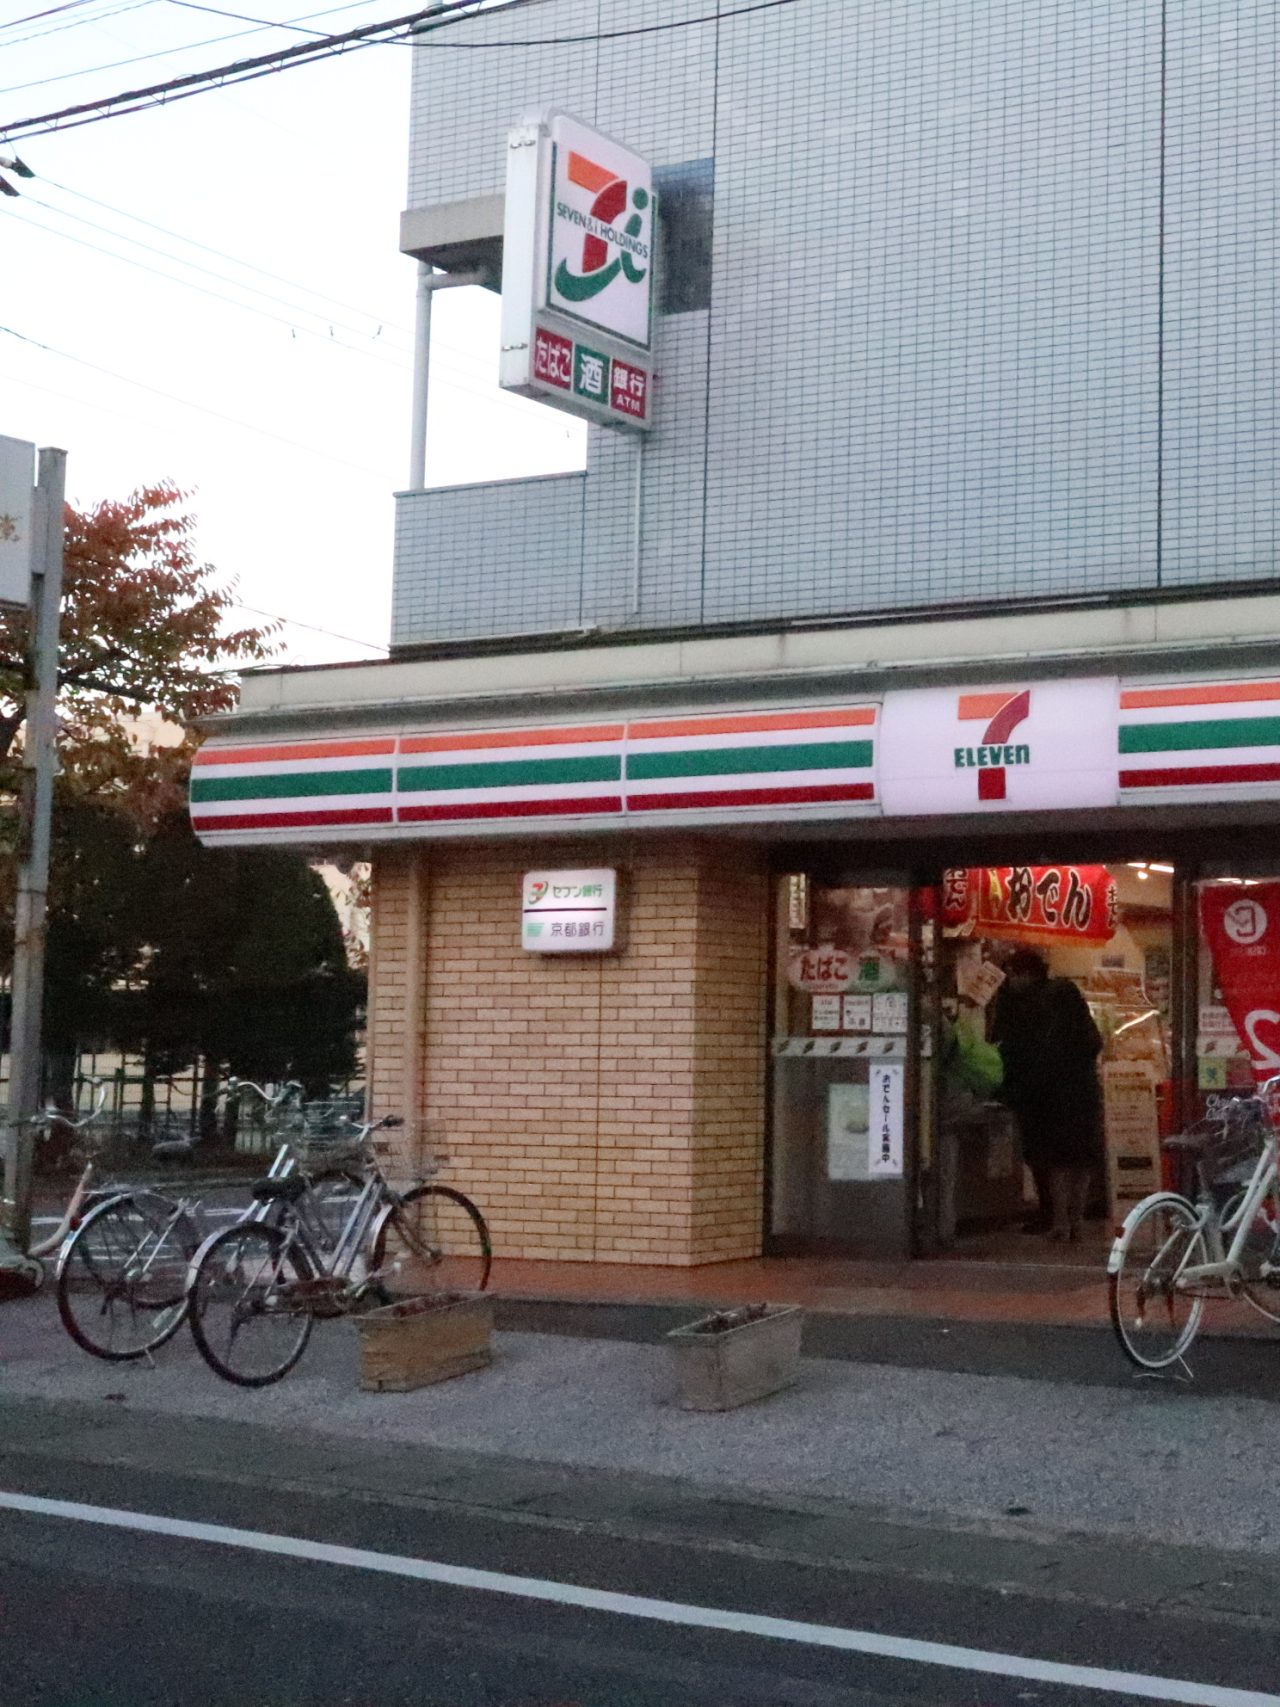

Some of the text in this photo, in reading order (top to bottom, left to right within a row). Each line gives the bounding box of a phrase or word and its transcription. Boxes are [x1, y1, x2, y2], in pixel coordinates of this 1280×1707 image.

[601, 224, 648, 259] HOLDINGS
[536, 337, 571, 383] たばこ
[580, 353, 603, 394] 酒
[614, 367, 644, 397] 銀行
[617, 394, 640, 412] ATM
[553, 884, 603, 899] セブン銀行
[1005, 866, 1091, 932] おでん
[550, 921, 605, 937] 京都銀行
[800, 956, 848, 982] たばこ
